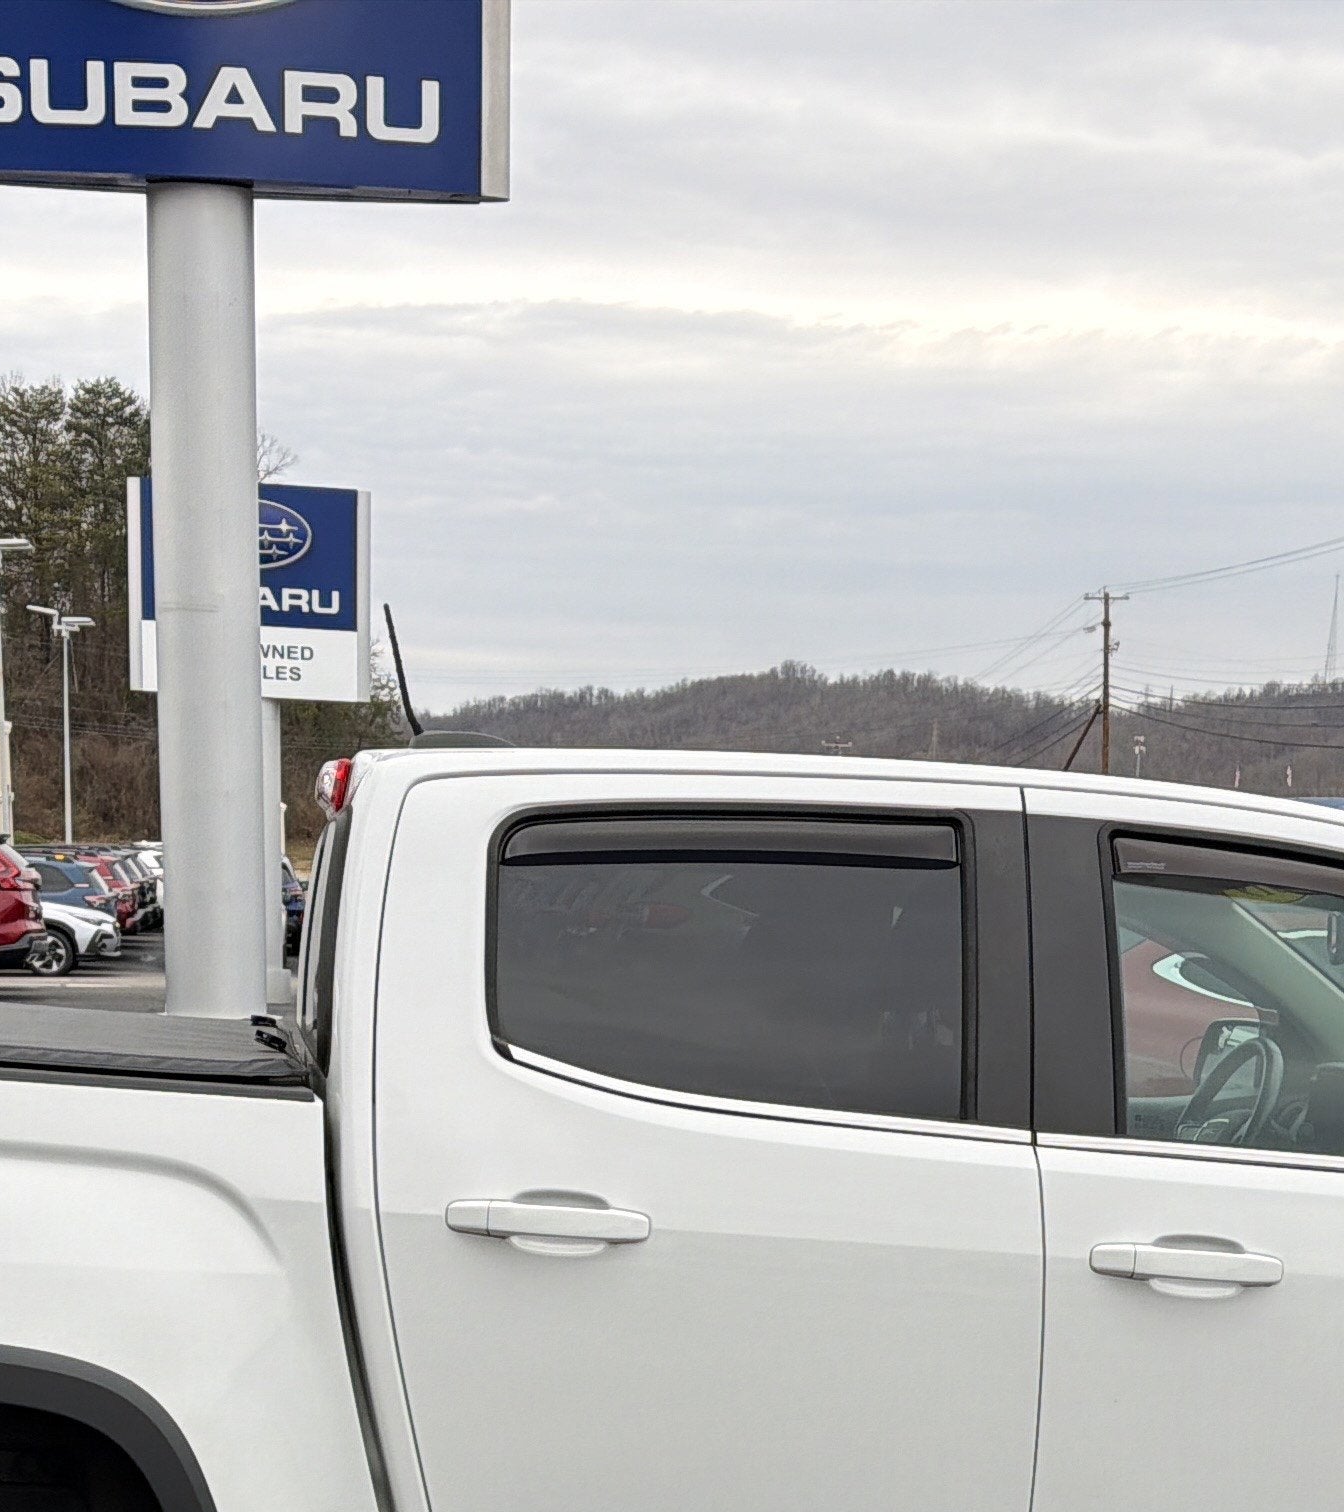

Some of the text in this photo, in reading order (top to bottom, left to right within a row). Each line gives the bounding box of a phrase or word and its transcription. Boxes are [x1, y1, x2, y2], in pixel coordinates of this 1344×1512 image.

[259, 586, 340, 615] ARU
[260, 643, 314, 661] WNED
[262, 664, 302, 681] LES
